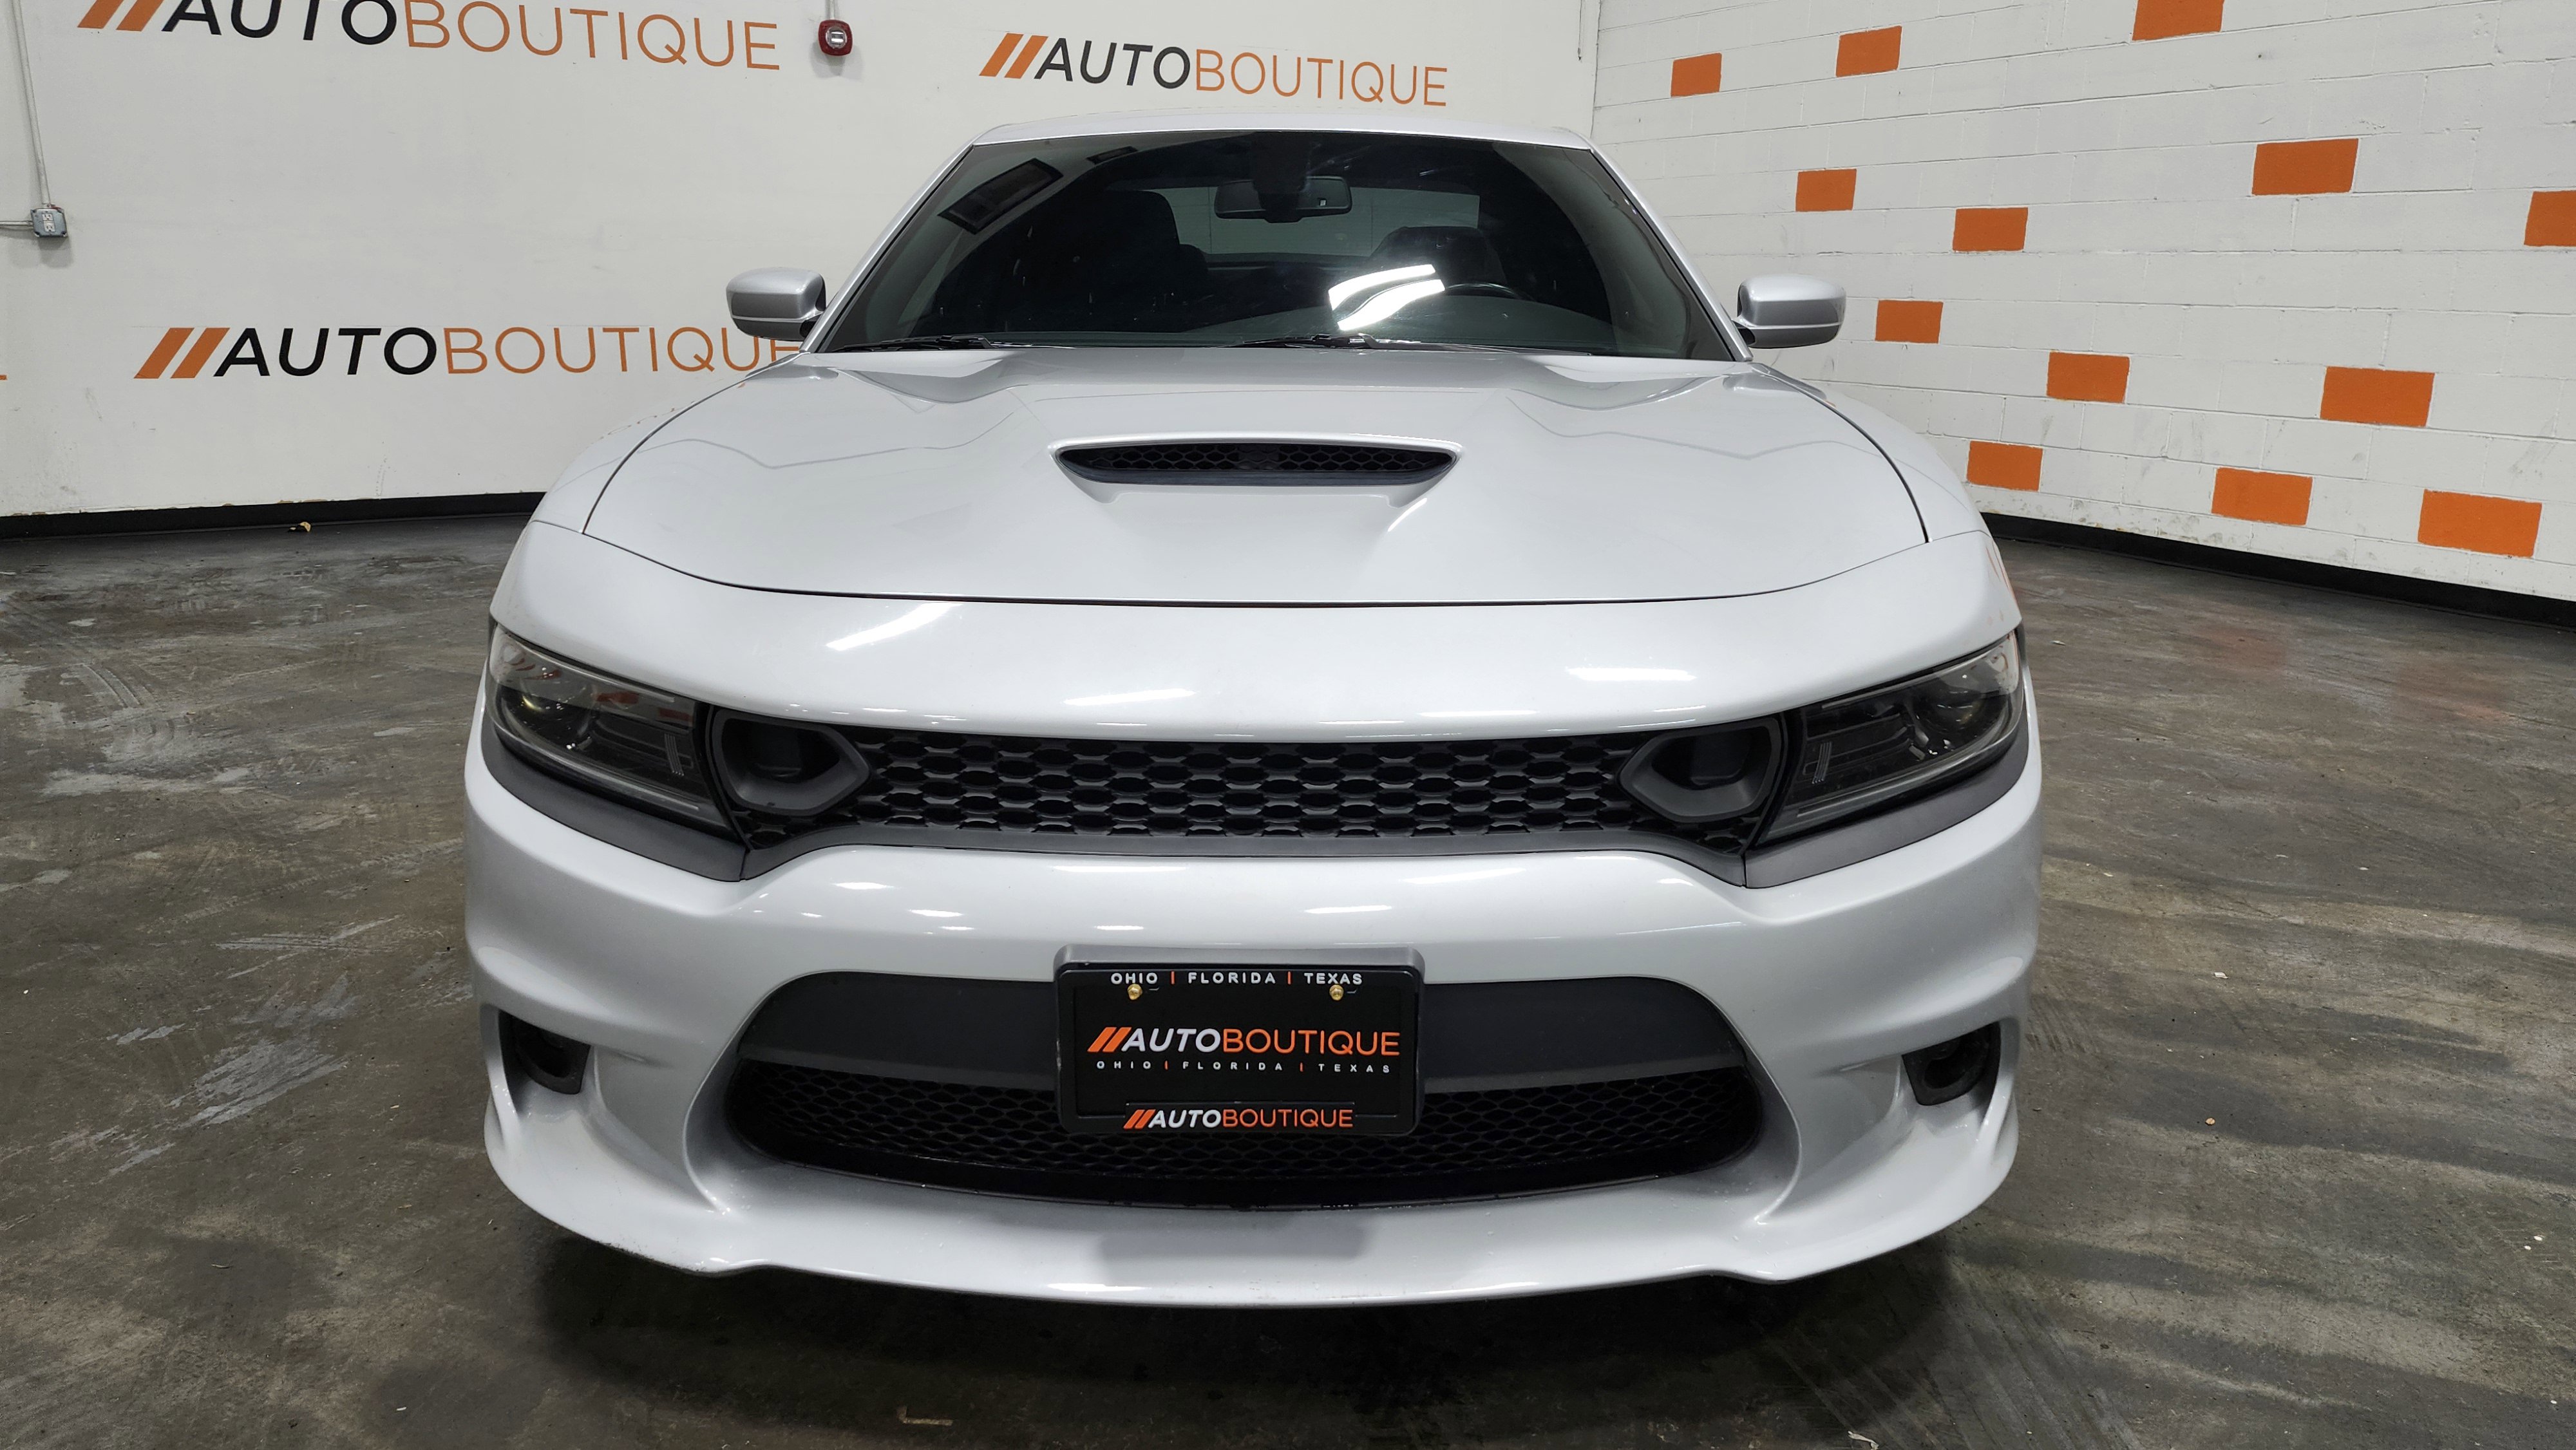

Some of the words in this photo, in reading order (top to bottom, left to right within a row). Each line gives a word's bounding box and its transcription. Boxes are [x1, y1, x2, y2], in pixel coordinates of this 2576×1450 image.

[1034, 37, 1447, 107] AUTOBOUTIQUE
[1111, 972, 1158, 984] OHIO
[1188, 972, 1276, 984] FLORIDA
[1303, 972, 1362, 985] TEXAS
[1121, 1028, 1400, 1056] AUTOBOUTIQUE
[1096, 1060, 1151, 1069] OHIO
[1182, 1061, 1282, 1071] FLORIDA
[1318, 1063, 1390, 1073] TEXAS
[1148, 1109, 1353, 1128] AUTOBOUTIQUE
